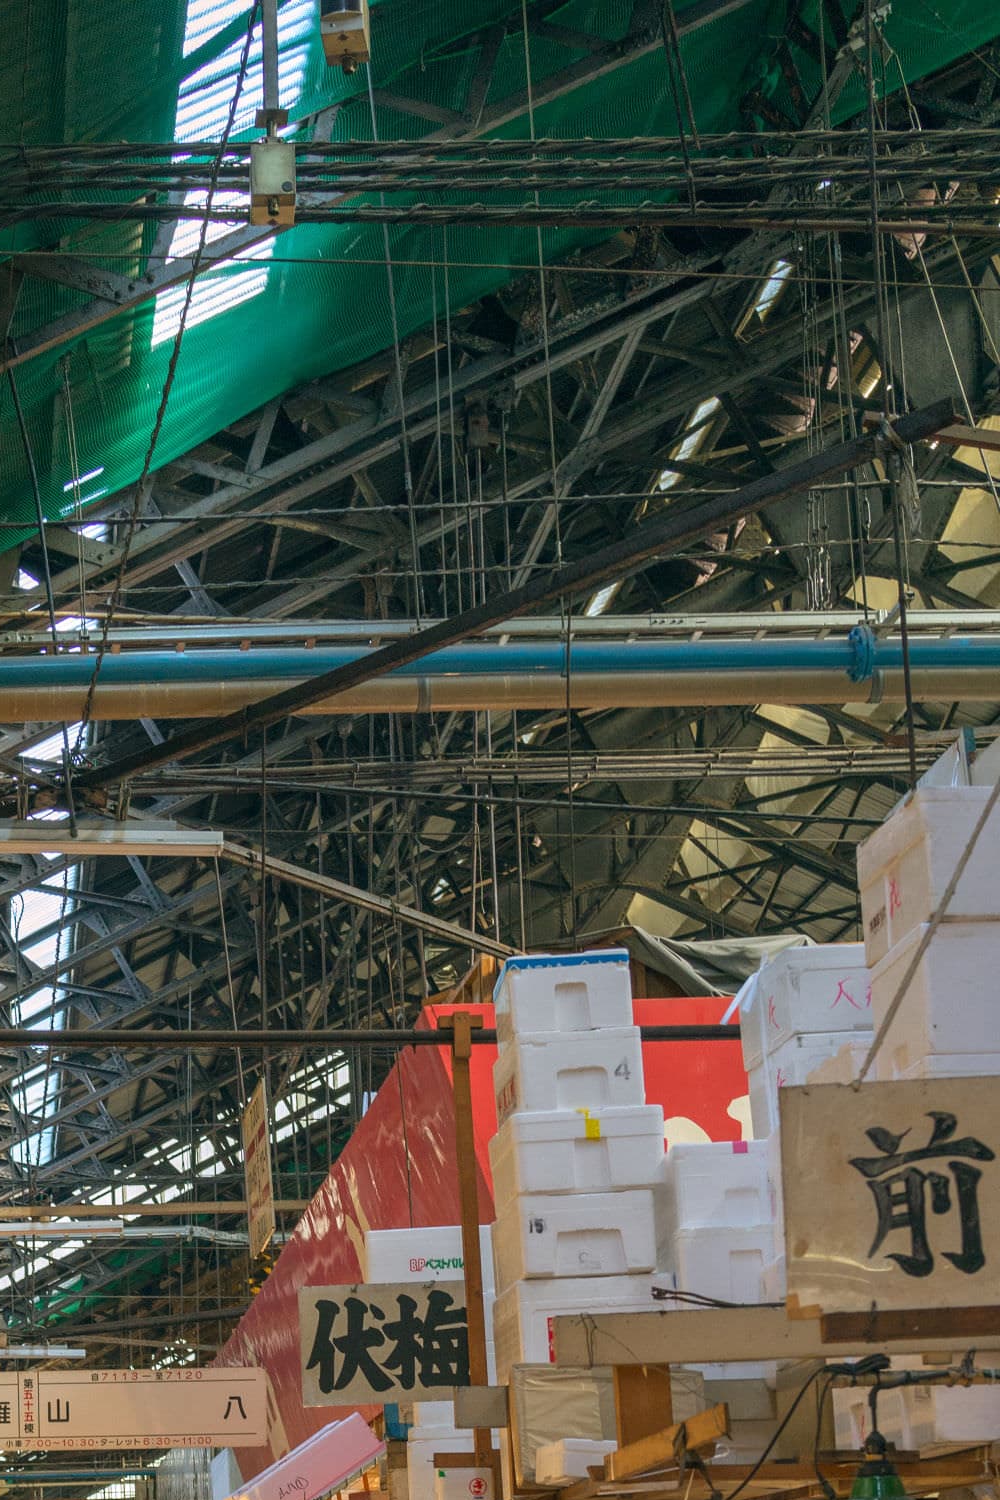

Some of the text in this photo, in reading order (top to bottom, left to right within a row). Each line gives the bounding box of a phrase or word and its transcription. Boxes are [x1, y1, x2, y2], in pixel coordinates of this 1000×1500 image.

[849, 1112, 996, 1277] 前
[306, 1290, 470, 1394] 伏梅
[23, 1378, 34, 1434] 第五十五棟
